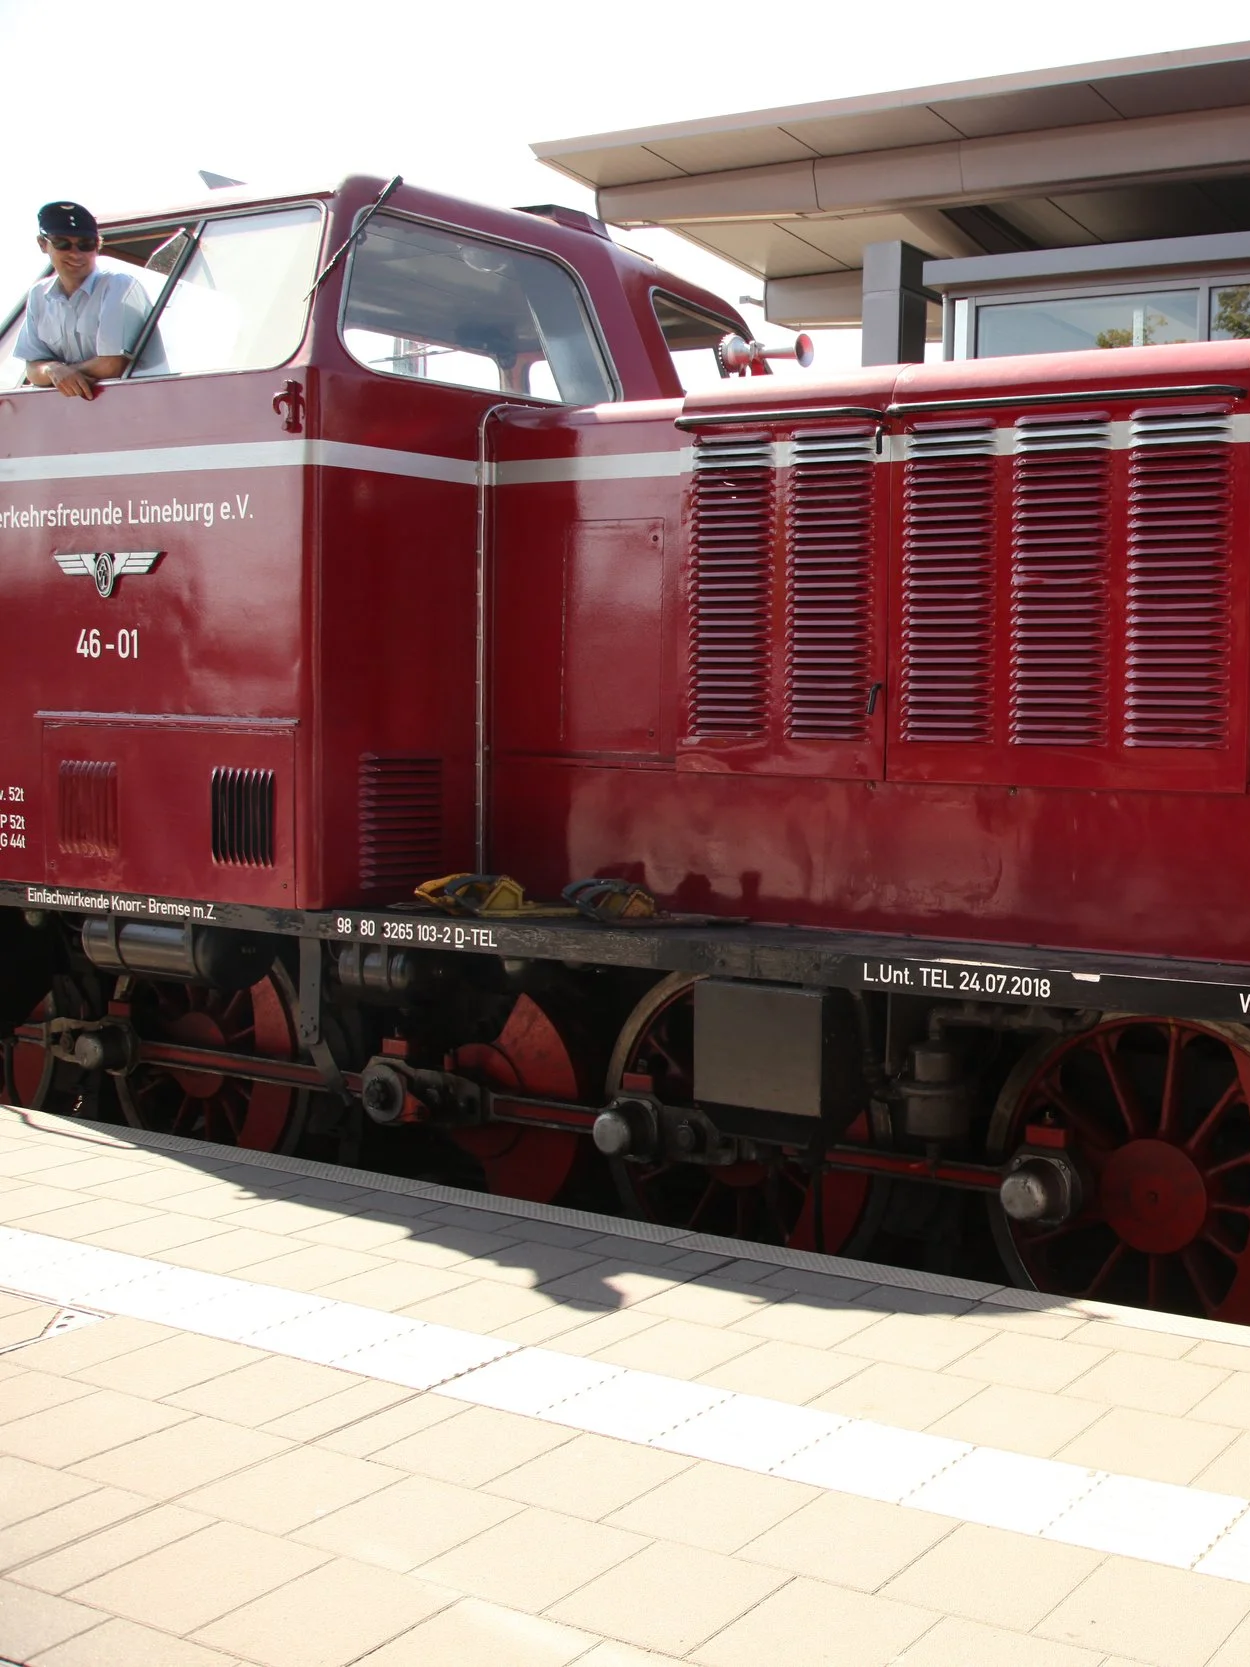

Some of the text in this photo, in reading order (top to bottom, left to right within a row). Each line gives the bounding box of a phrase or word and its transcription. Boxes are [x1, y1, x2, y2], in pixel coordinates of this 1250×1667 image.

[0, 494, 253, 528] rkehrsfreunde Lüneburg e.V.
[9, 787, 24, 801] 52t
[10, 815, 25, 829] 52t
[10, 834, 25, 848] 44t
[27, 887, 110, 909] Einfachwirkende
[149, 898, 190, 917] Bremse
[193, 904, 216, 920] m.Z.
[337, 917, 497, 948] 98 80 3265 103-2 D-TEL
[863, 962, 1051, 998] L.Unt. TEL 24.07.2018
